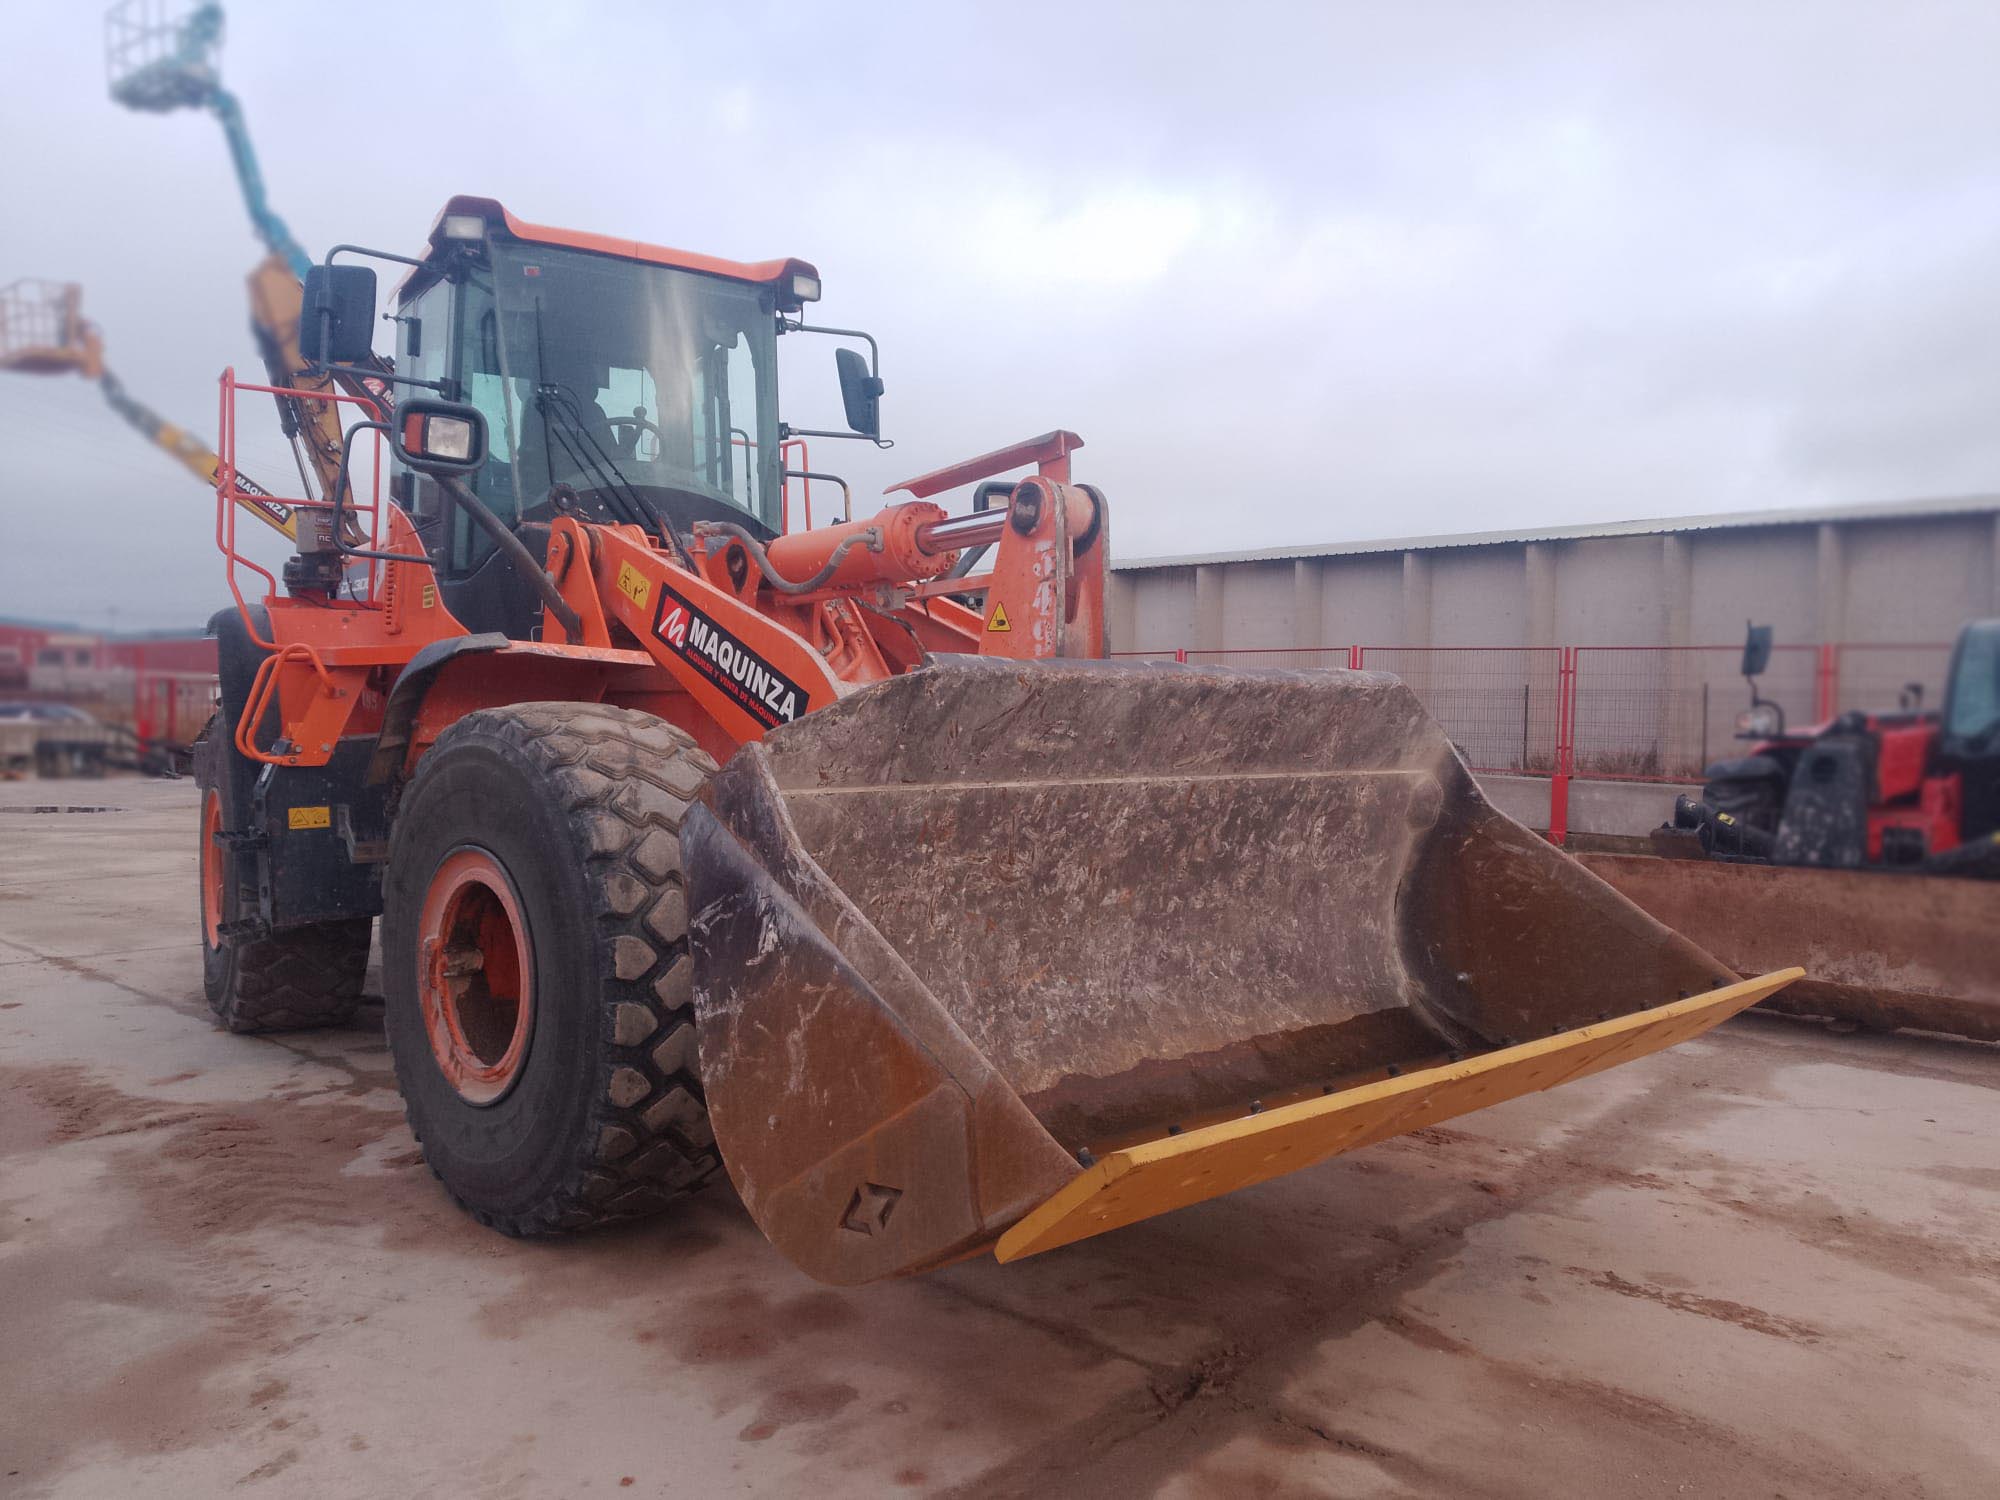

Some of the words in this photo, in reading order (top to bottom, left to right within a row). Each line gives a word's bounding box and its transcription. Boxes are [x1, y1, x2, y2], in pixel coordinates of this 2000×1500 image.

[689, 617, 796, 721] MAQUINZA
[719, 674, 739, 695] VENTA
[739, 690, 749, 702] DE
[748, 698, 782, 726] MAQUINA
